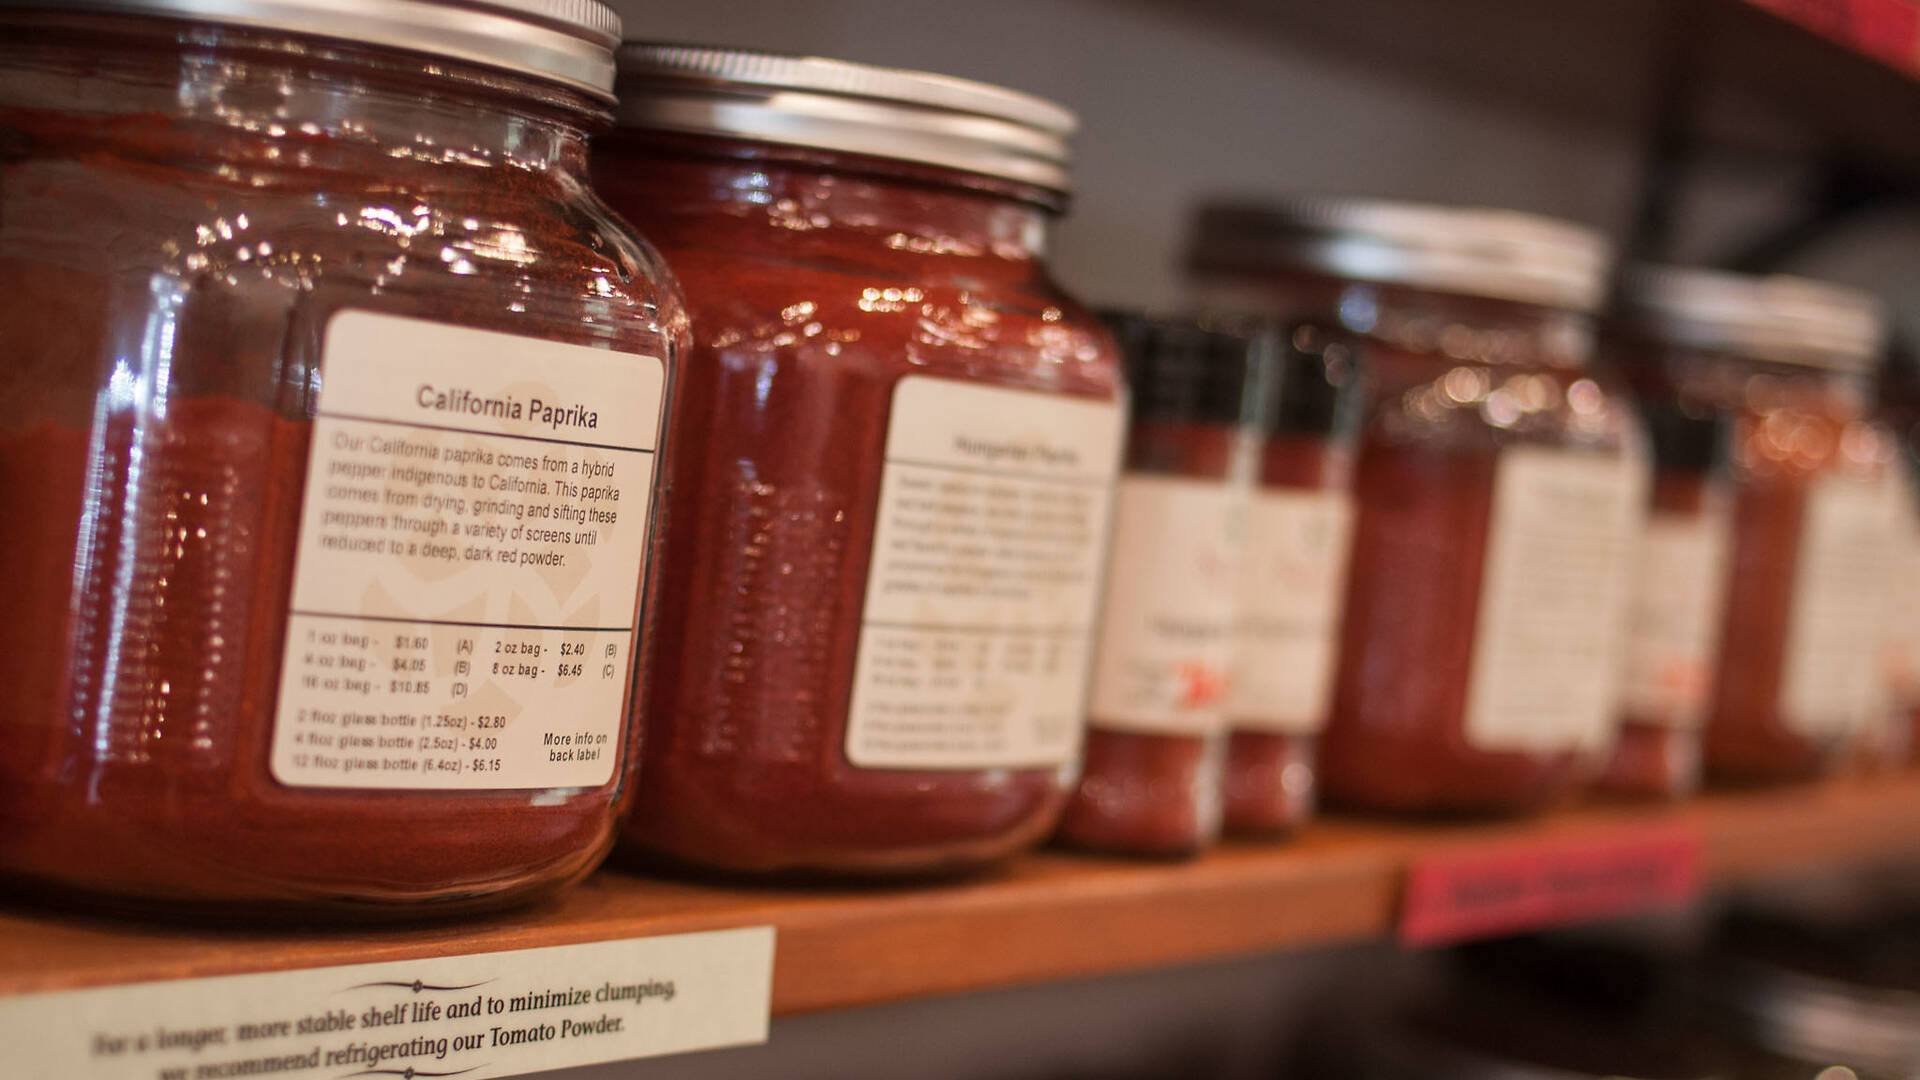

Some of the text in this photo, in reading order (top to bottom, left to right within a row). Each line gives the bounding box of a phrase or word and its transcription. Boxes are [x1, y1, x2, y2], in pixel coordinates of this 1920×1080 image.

[416, 385, 599, 429] California Paprika
[334, 431, 615, 479] Our California paprika comes from a hybrid
[328, 460, 620, 502] pepper indigenous to California. This paprika
[327, 485, 617, 525] comes from drying, grinding and sifting these
[322, 511, 597, 545] peppers through a variety of screens until
[321, 535, 565, 568] reduced to a deep, dark red powder.
[321, 633, 337, 645] oz
[342, 633, 369, 649] bag
[395, 635, 429, 650] $1.60
[457, 639, 474, 655] (A)
[495, 641, 501, 653] 2
[504, 643, 518, 654] oz
[521, 642, 540, 657] bag
[560, 643, 585, 656] $2.40
[605, 643, 617, 659] (B)
[319, 656, 335, 667] oz
[339, 656, 366, 672] bag
[392, 658, 426, 672] $4.05
[454, 660, 471, 676] (B)
[492, 662, 499, 675] 8
[502, 664, 515, 675] oz
[518, 664, 538, 679] bag
[557, 664, 583, 677] $6.45
[602, 663, 615, 679] (C)
[324, 678, 339, 691] oz
[344, 678, 372, 694] bag
[451, 682, 468, 698] (D)
[342, 712, 377, 728] glass
[381, 713, 417, 727] bottle
[421, 715, 468, 730] (1.25oz)
[477, 715, 506, 729] $2.80
[339, 735, 374, 749] glass
[379, 735, 414, 749] bottle
[419, 737, 458, 751] (2.5oz)
[469, 737, 497, 751] $4.00
[544, 732, 608, 745] More info on
[549, 748, 600, 761] back label
[344, 757, 378, 772] glass
[383, 757, 418, 771] bottle
[423, 758, 462, 774] (6.4oz)
[472, 758, 501, 772] $6.15
[236, 1022, 292, 1042] more
[295, 1009, 356, 1034] stable
[361, 1004, 408, 1028] shelf
[411, 1001, 441, 1023] life
[447, 996, 482, 1019] and
[487, 996, 504, 1014] to
[509, 987, 592, 1013] minimize
[158, 1014, 624, 1080] we recommend refrigerating our Tomato Powder.
